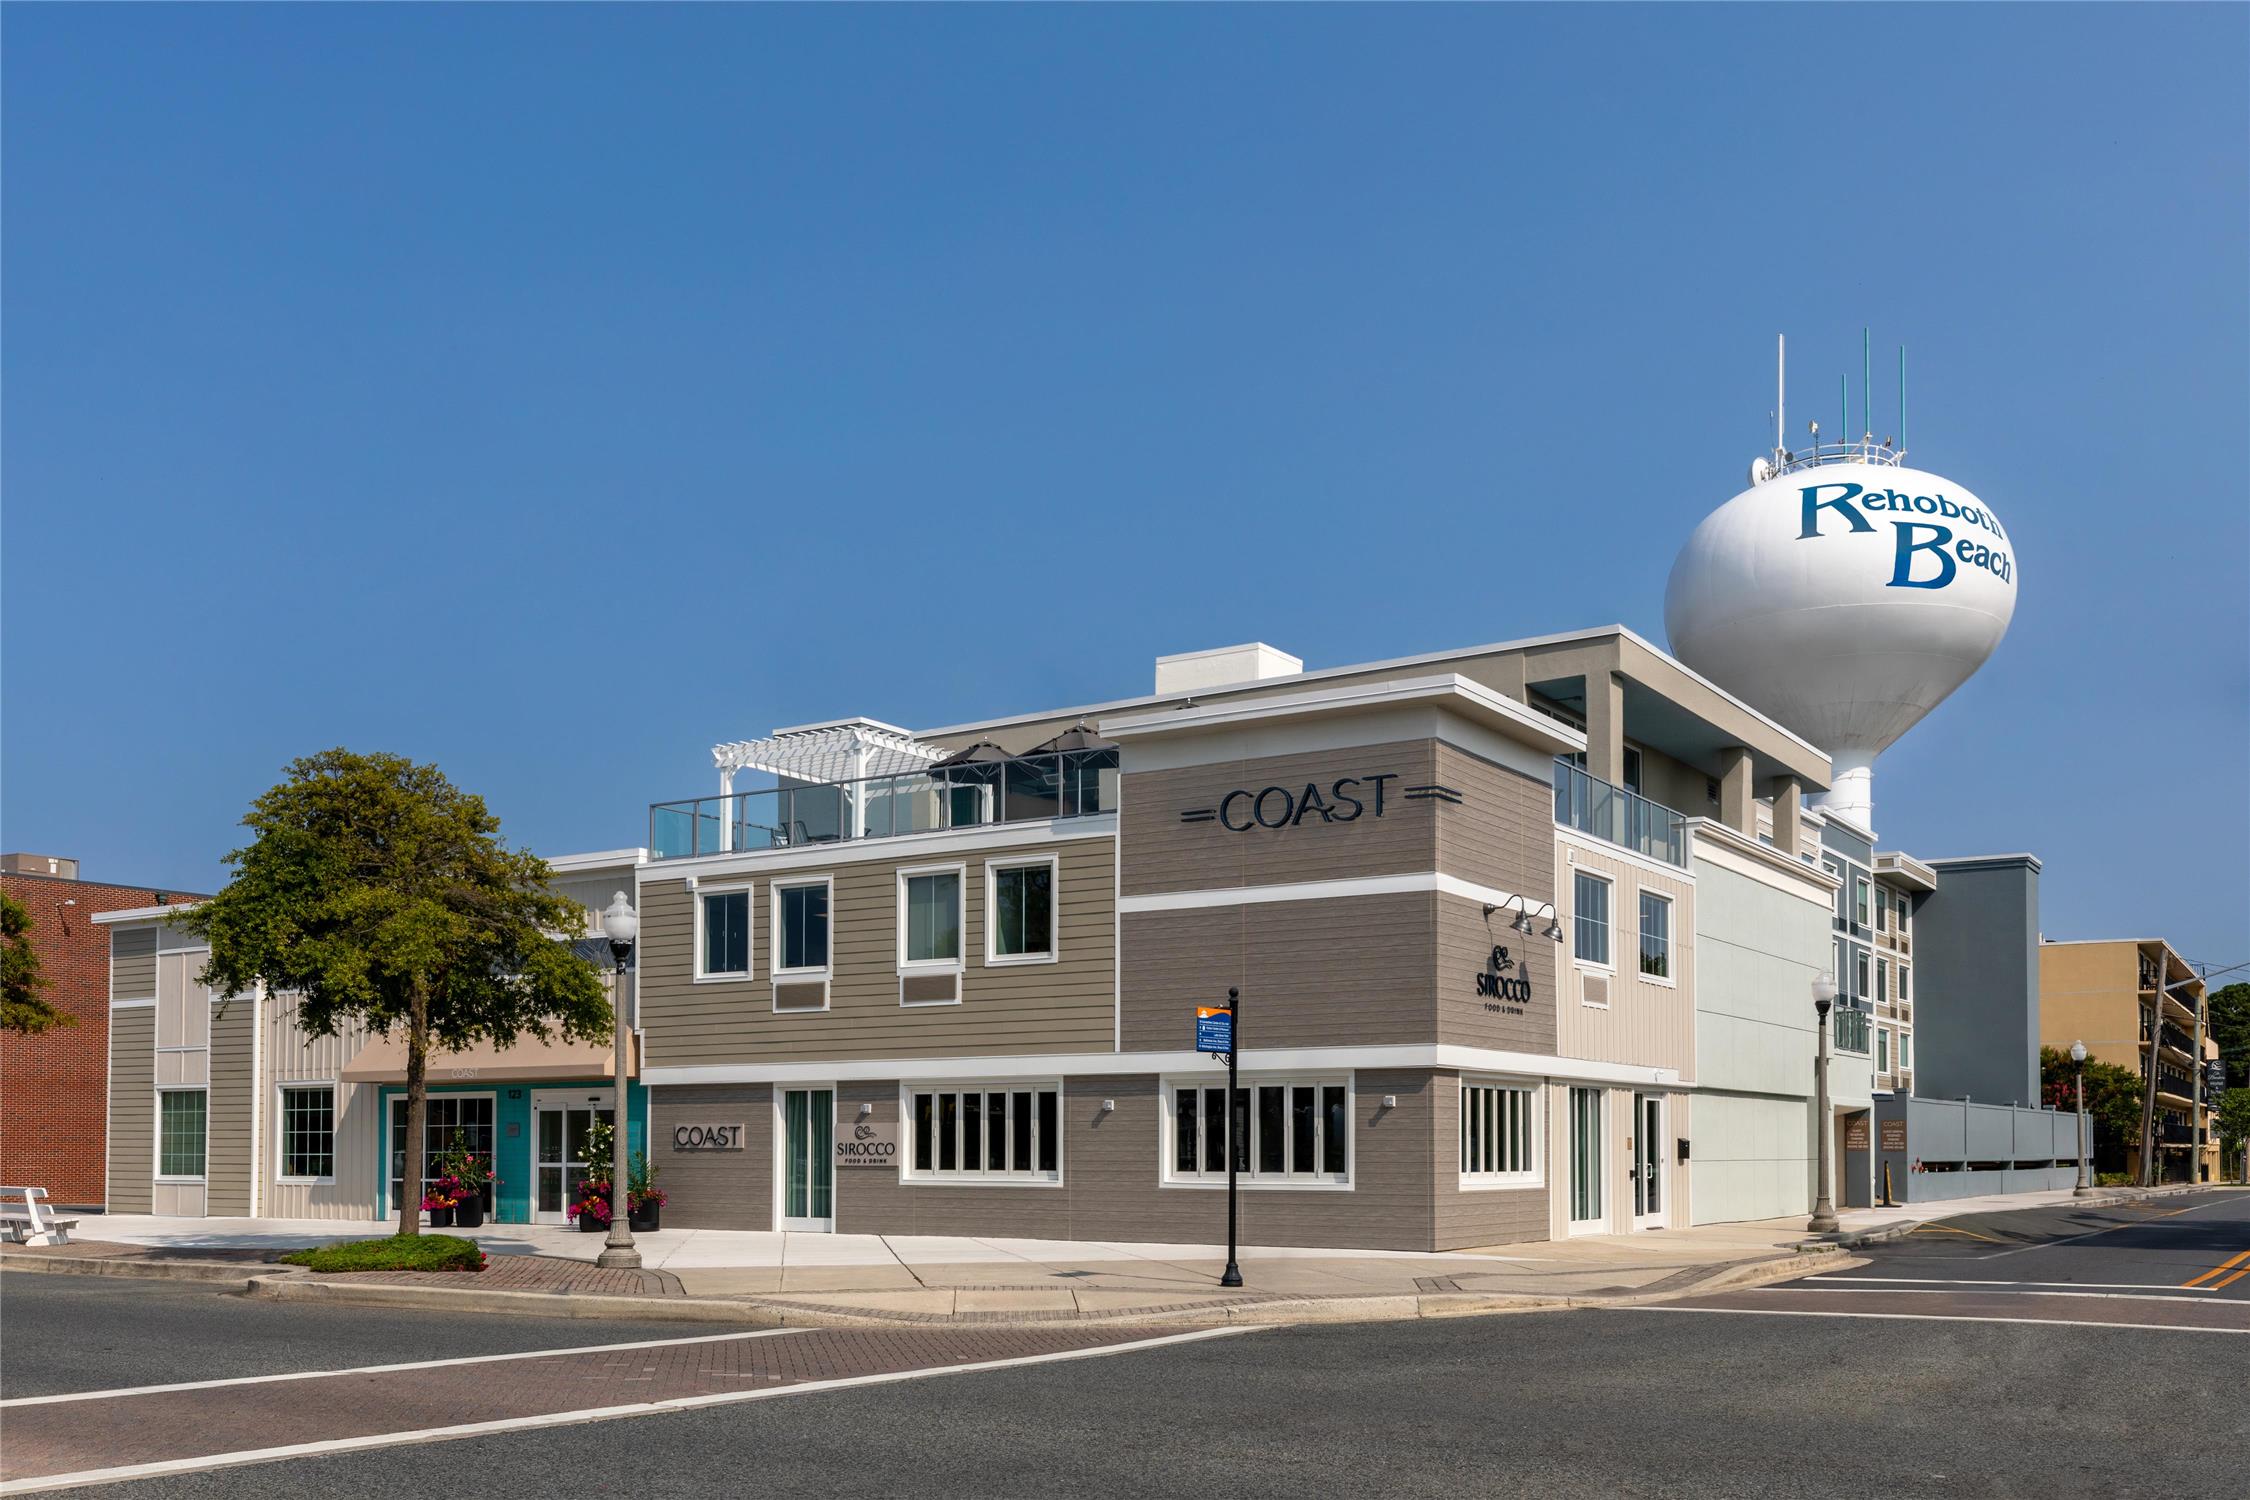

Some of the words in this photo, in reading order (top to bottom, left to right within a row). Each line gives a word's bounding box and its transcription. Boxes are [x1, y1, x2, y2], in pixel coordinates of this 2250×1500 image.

[1795, 482, 2005, 541] Rehoboth
[1886, 521, 2012, 590] Beach
[1219, 773, 1399, 832] COAST
[1476, 972, 1531, 1004] SIROCCO
[1484, 1002, 1500, 1013] FOOD
[1507, 1006, 1524, 1016] DRINK
[451, 1067, 480, 1079] COAST
[508, 1089, 522, 1099] 123
[675, 1126, 741, 1146] COAST
[836, 1142, 896, 1156] SIROCCO
